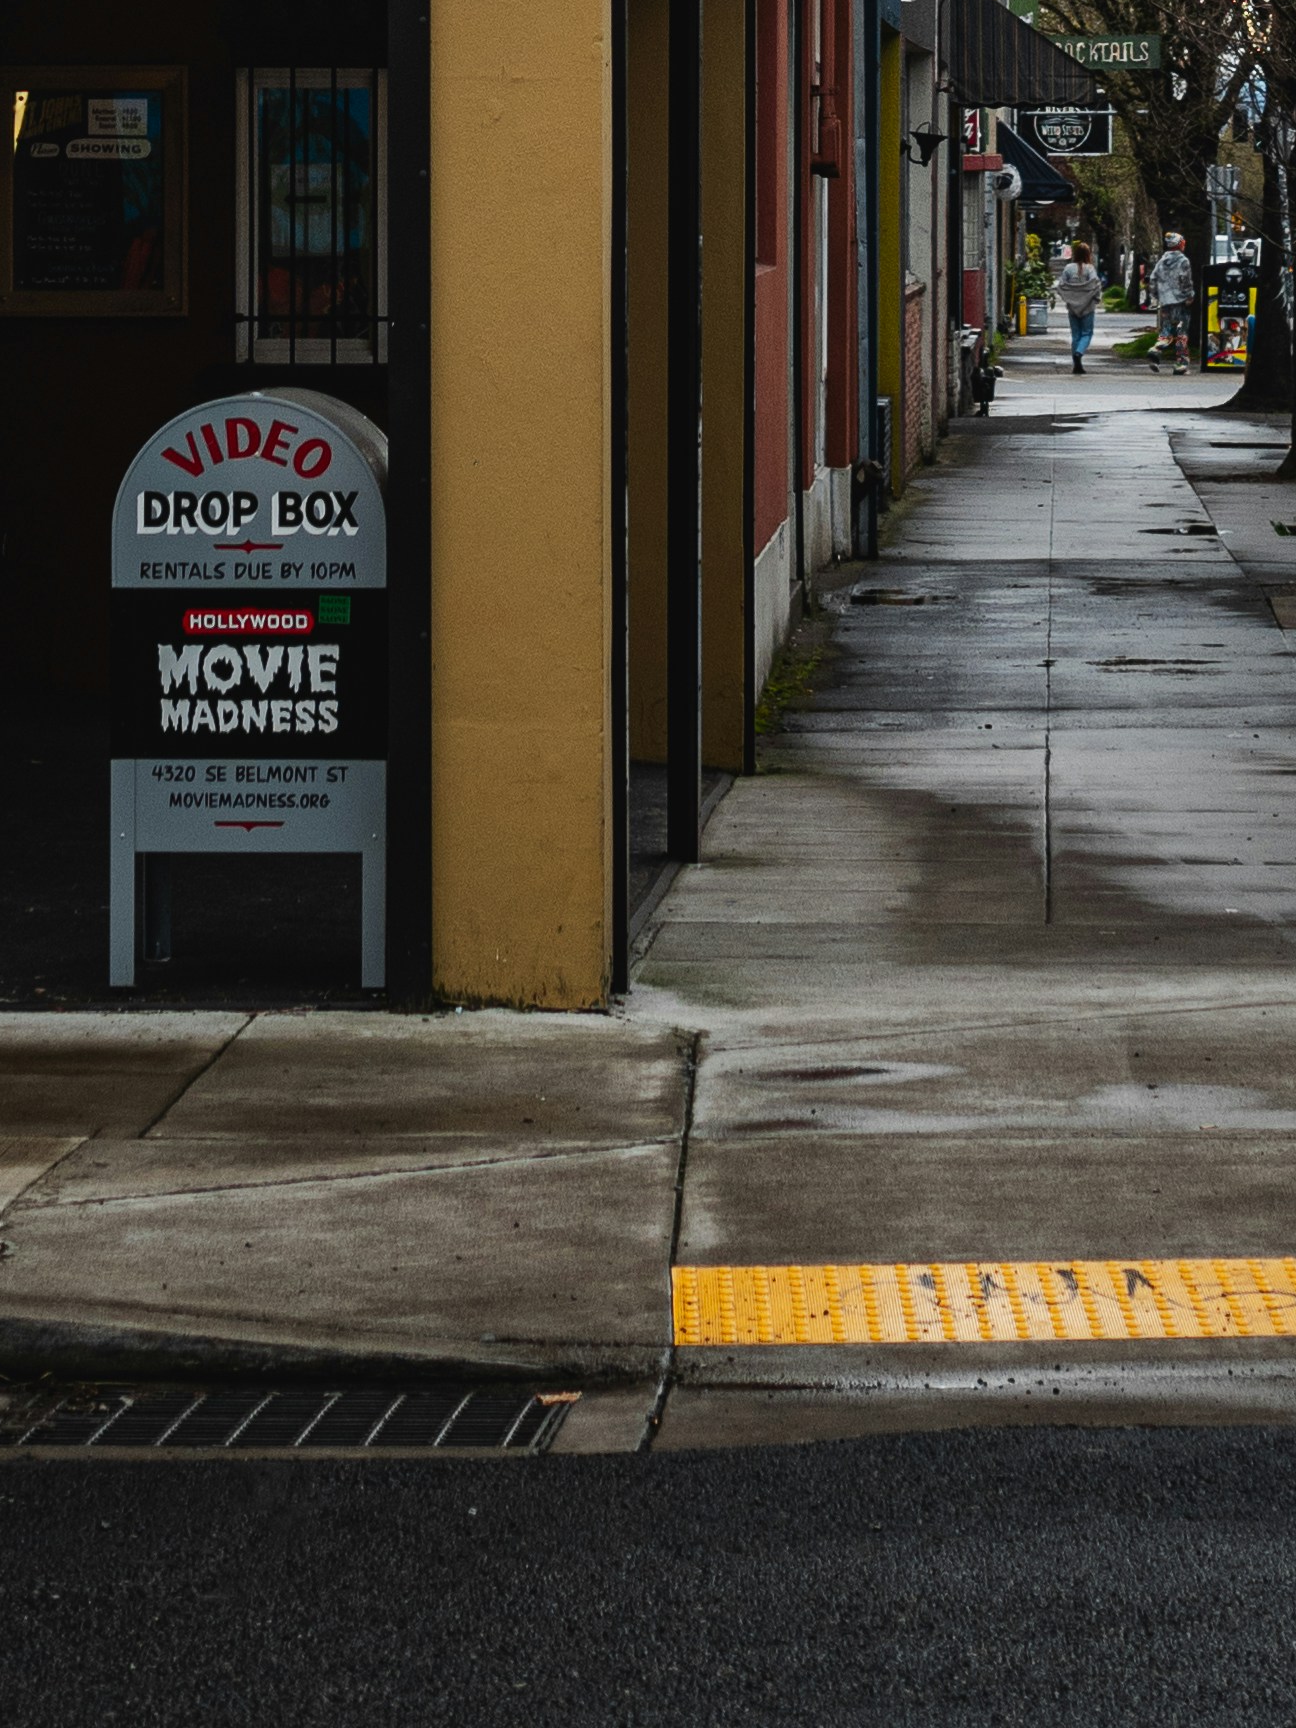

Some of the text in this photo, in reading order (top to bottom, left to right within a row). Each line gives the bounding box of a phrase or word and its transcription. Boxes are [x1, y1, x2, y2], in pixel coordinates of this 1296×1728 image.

[70, 143, 142, 153] SHOWING
[160, 416, 333, 480] VIDEO
[137, 491, 360, 536] DROP BOX
[139, 561, 357, 582] RENTALS DUE BY 10PM
[188, 612, 309, 631] HOLLYWOOD
[157, 643, 341, 696] MOVIE
[160, 698, 339, 735] MADNESS
[151, 764, 349, 784] 4320 SE BELMONT ST
[168, 791, 331, 810] MOVIEMADNESS.ORG
